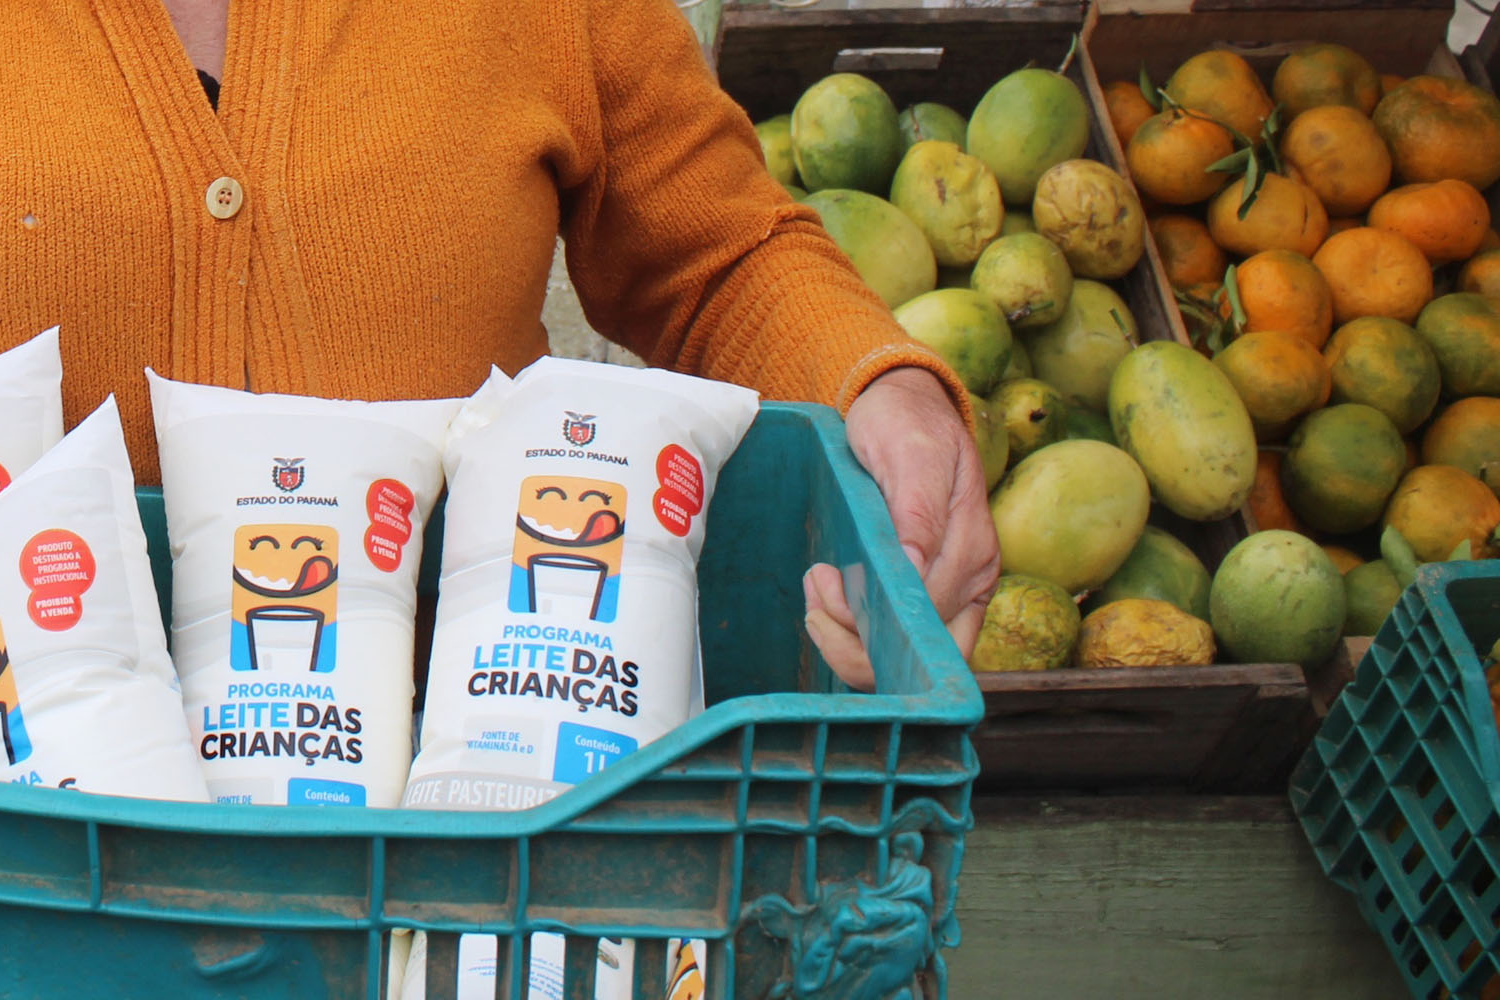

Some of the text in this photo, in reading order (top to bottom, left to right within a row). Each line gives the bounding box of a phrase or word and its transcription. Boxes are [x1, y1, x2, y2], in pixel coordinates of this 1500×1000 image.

[525, 448, 629, 466] ESTADO DO PARANÁ
[236, 495, 339, 507] ESTADO DO PARANÁ
[37, 541, 73, 553] PRODUTO
[32, 551, 81, 565] DESTINADO A
[37, 562, 80, 575] PROGRAMA
[33, 571, 88, 586] INSTITUCIONAL
[35, 596, 75, 608] PROIBIDA
[47, 606, 74, 617] VENDA
[503, 624, 613, 651] PROGRAMA
[473, 643, 639, 688] LEITE DAS
[227, 682, 335, 701] PROGRAMA
[467, 671, 639, 717] CRIANÇAS
[203, 702, 363, 735] LEITE DAS
[508, 732, 520, 741] DE
[200, 731, 364, 766] CRIANÇAS
[511, 743, 518, 752] A
[526, 744, 534, 754] D
[574, 735, 621, 754] Conteúdo
[304, 788, 351, 804] Conteúdo
